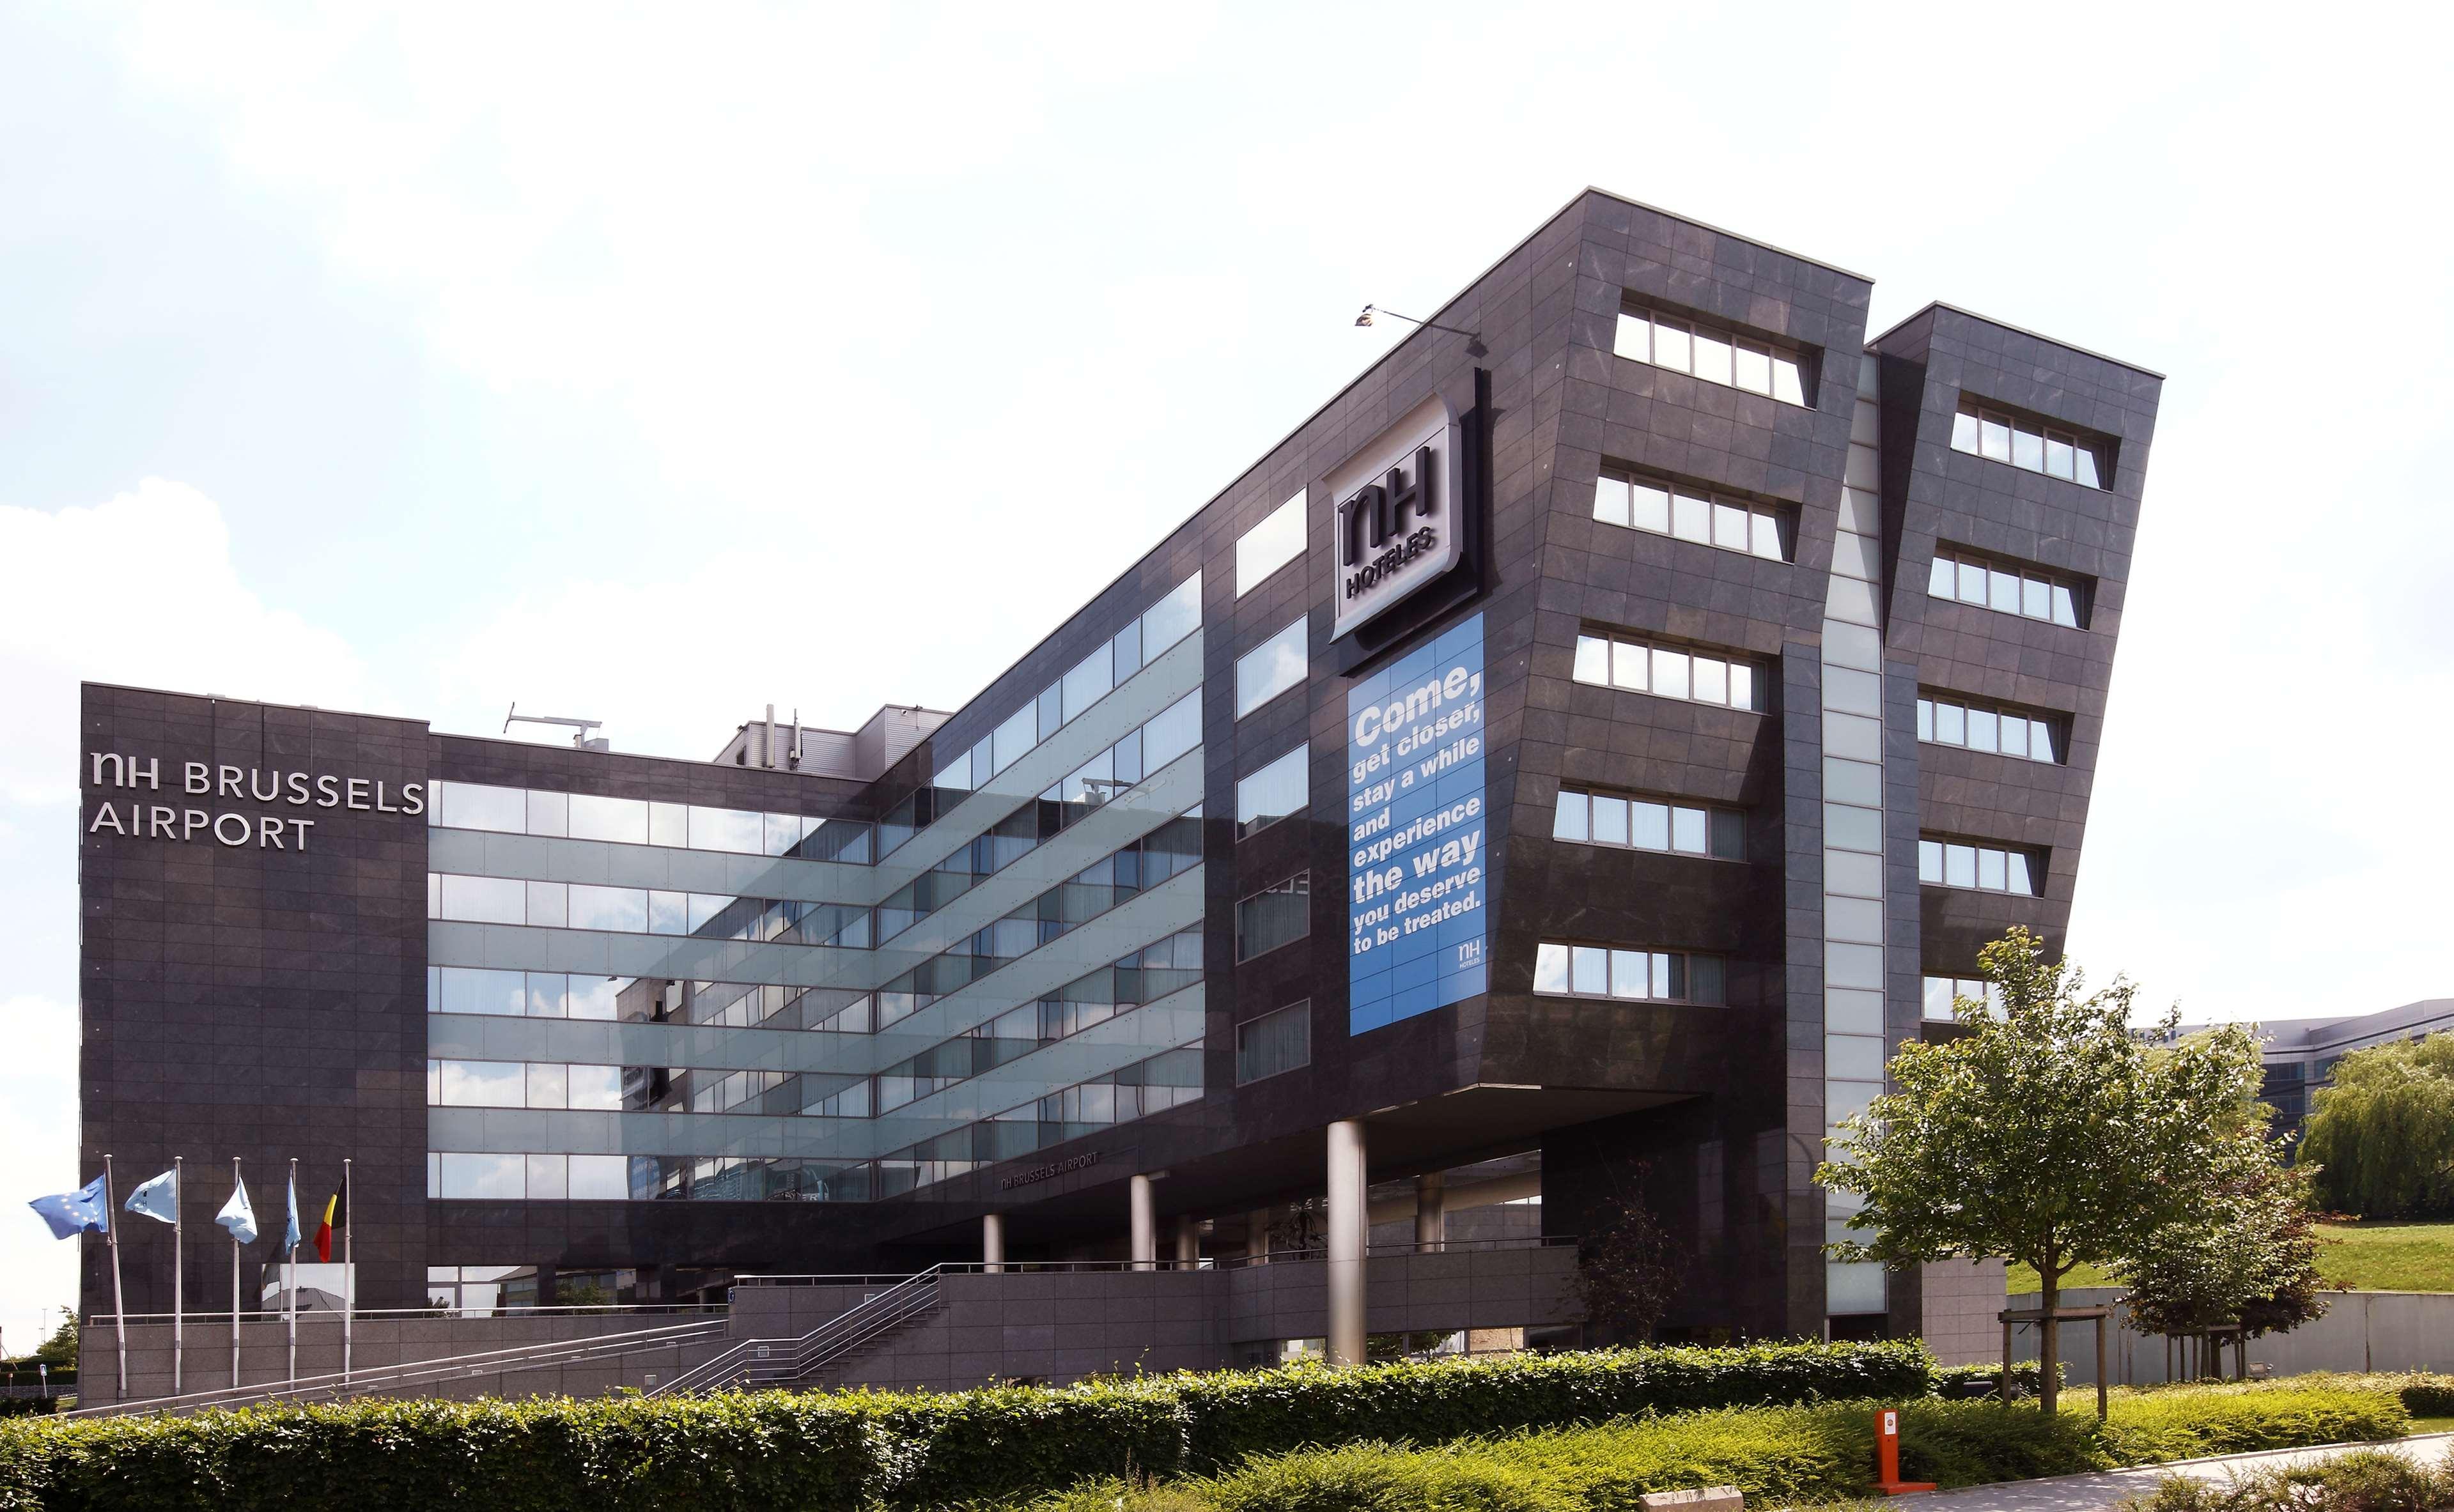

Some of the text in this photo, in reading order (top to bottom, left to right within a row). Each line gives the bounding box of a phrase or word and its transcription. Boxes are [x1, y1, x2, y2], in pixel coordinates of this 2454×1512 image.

[1346, 527, 1433, 599] HOTELES
[1355, 667, 1480, 746] Come,
[1353, 701, 1480, 784] get closer,
[1353, 737, 1480, 812] stay a while
[185, 762, 424, 815] BRUSSELS
[89, 802, 315, 851] AIRPORT
[1353, 807, 1390, 842] and
[1354, 798, 1480, 867] experience
[1354, 830, 1480, 904] the way
[1354, 867, 1480, 935] you deserve
[1354, 890, 1480, 954] to be treated.
[1459, 957, 1480, 969] HOTELES
[1014, 1164, 1055, 1187] BRUSSELS
[1058, 1152, 1098, 1174] AIRPORT
